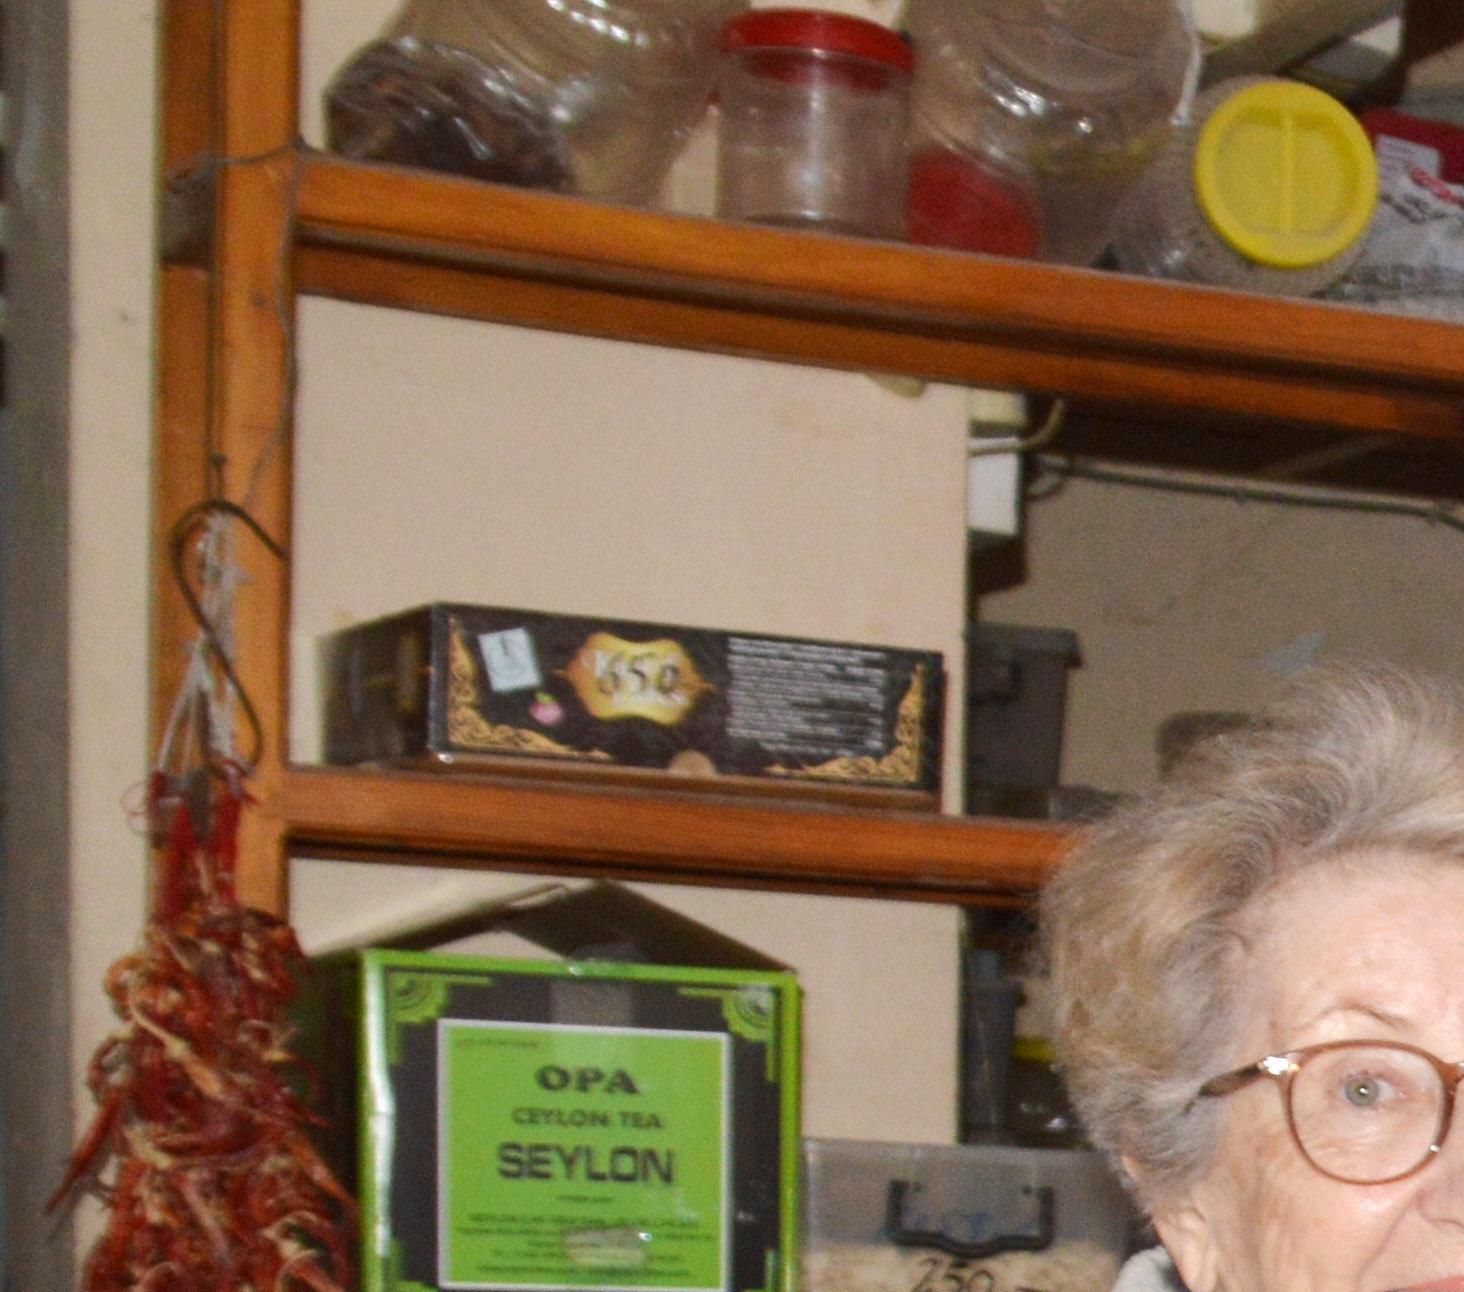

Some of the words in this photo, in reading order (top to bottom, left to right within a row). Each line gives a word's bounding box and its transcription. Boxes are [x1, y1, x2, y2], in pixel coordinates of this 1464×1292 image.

[536, 1064, 642, 1095] OPA
[511, 1106, 610, 1130] CEYLON
[617, 1108, 665, 1131] TEA
[497, 1140, 676, 1184] SEYLON
